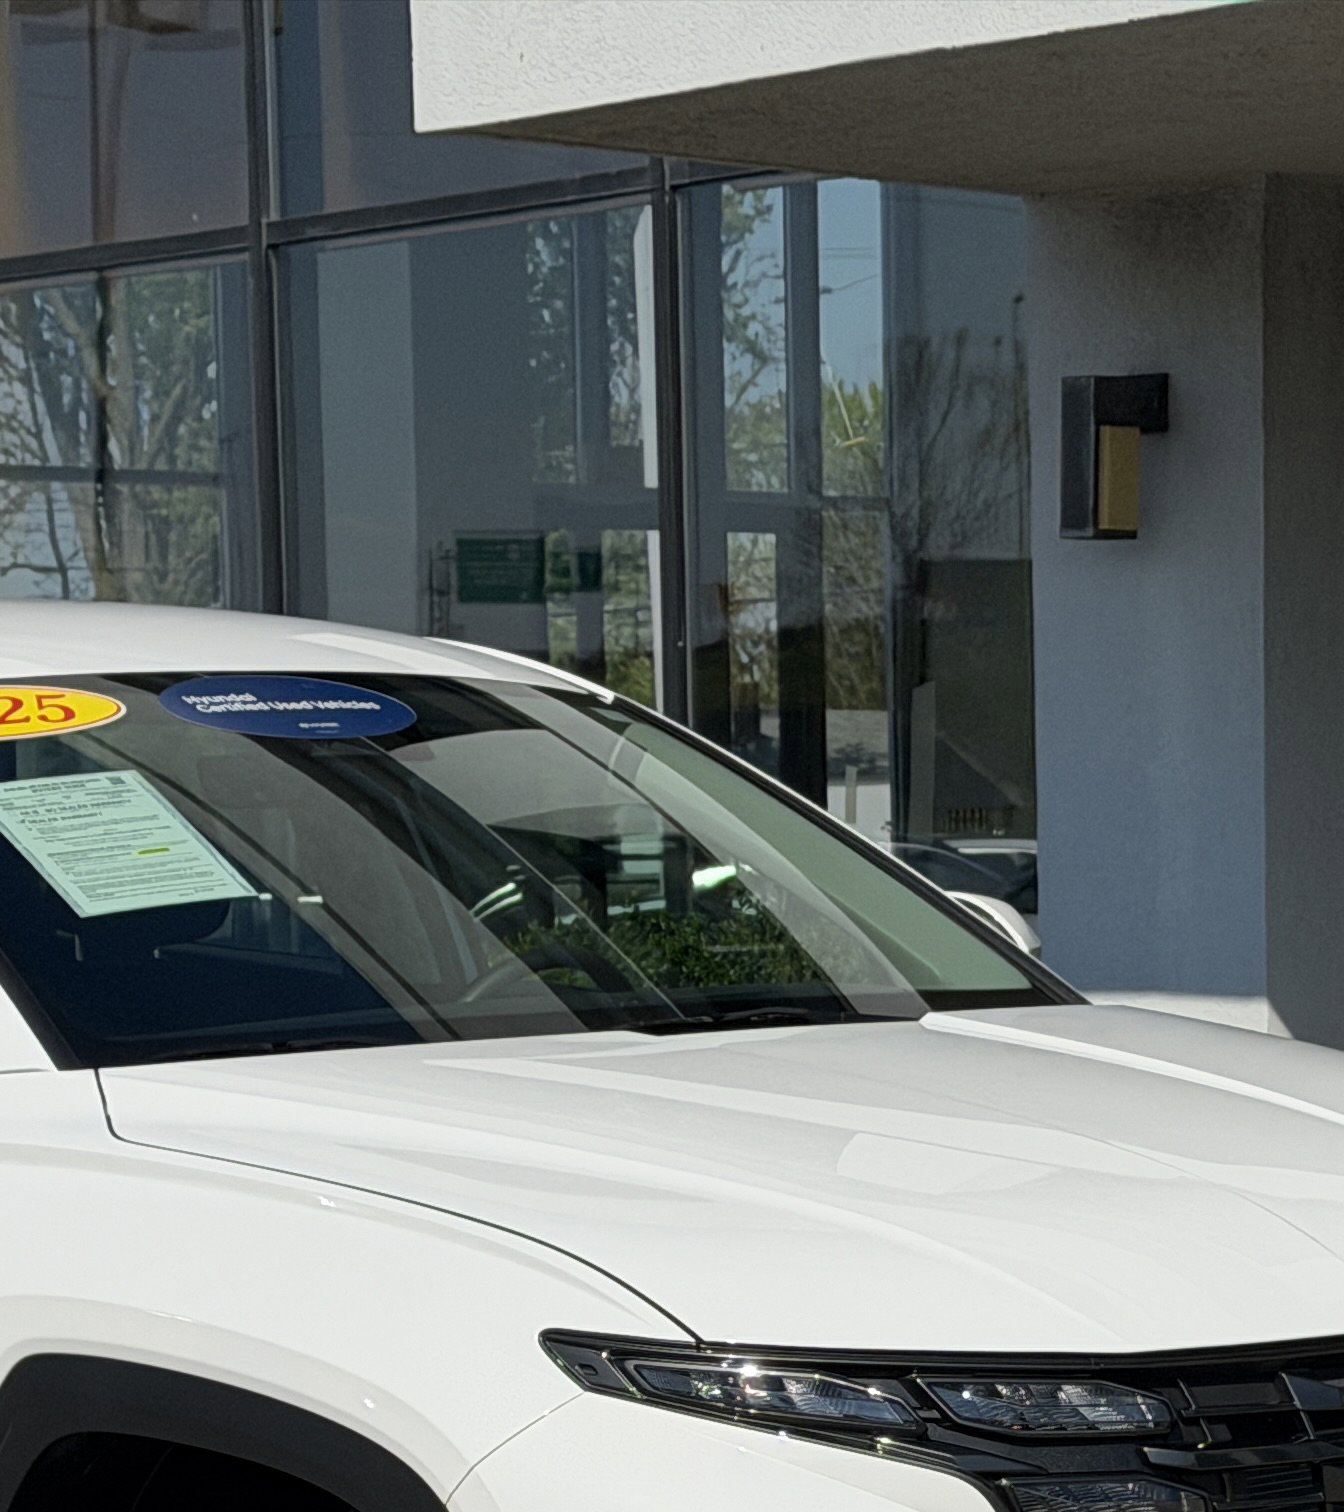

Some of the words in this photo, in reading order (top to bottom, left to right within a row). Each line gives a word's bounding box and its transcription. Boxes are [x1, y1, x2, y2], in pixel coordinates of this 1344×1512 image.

[181, 693, 258, 705] Hyundai
[196, 702, 270, 713] Certified
[267, 701, 314, 711] Used
[310, 700, 382, 710] Vehicles
